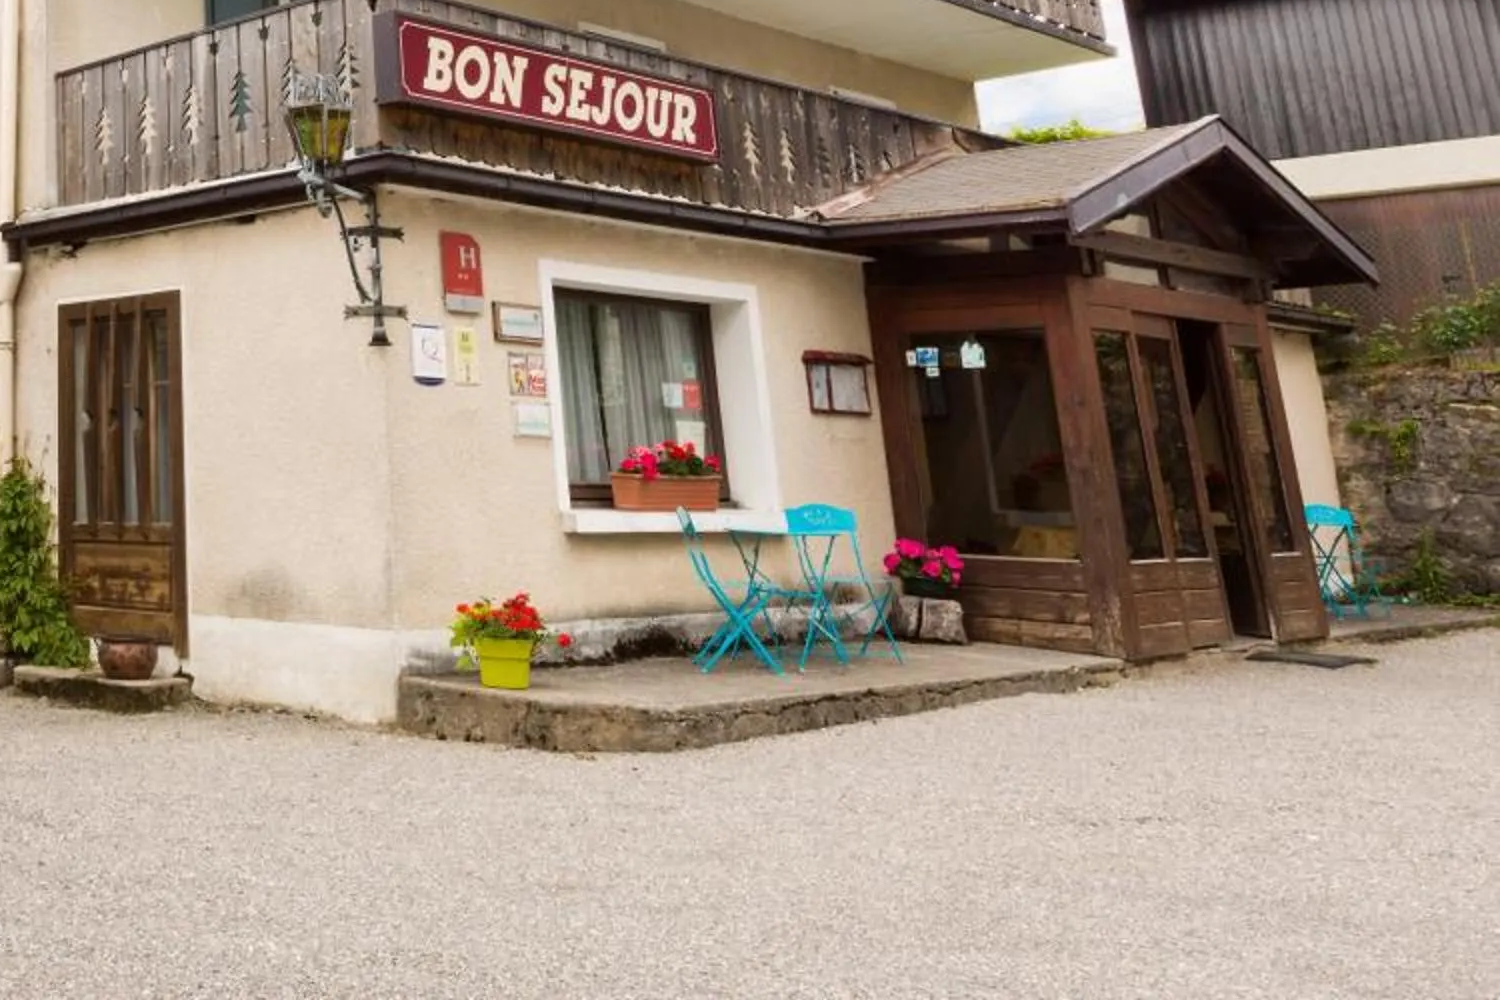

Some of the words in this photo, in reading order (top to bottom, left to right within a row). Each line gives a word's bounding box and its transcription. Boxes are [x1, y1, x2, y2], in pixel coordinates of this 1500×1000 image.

[423, 36, 528, 108] BON
[541, 63, 698, 144] SEJOUR
[458, 245, 477, 270] H
